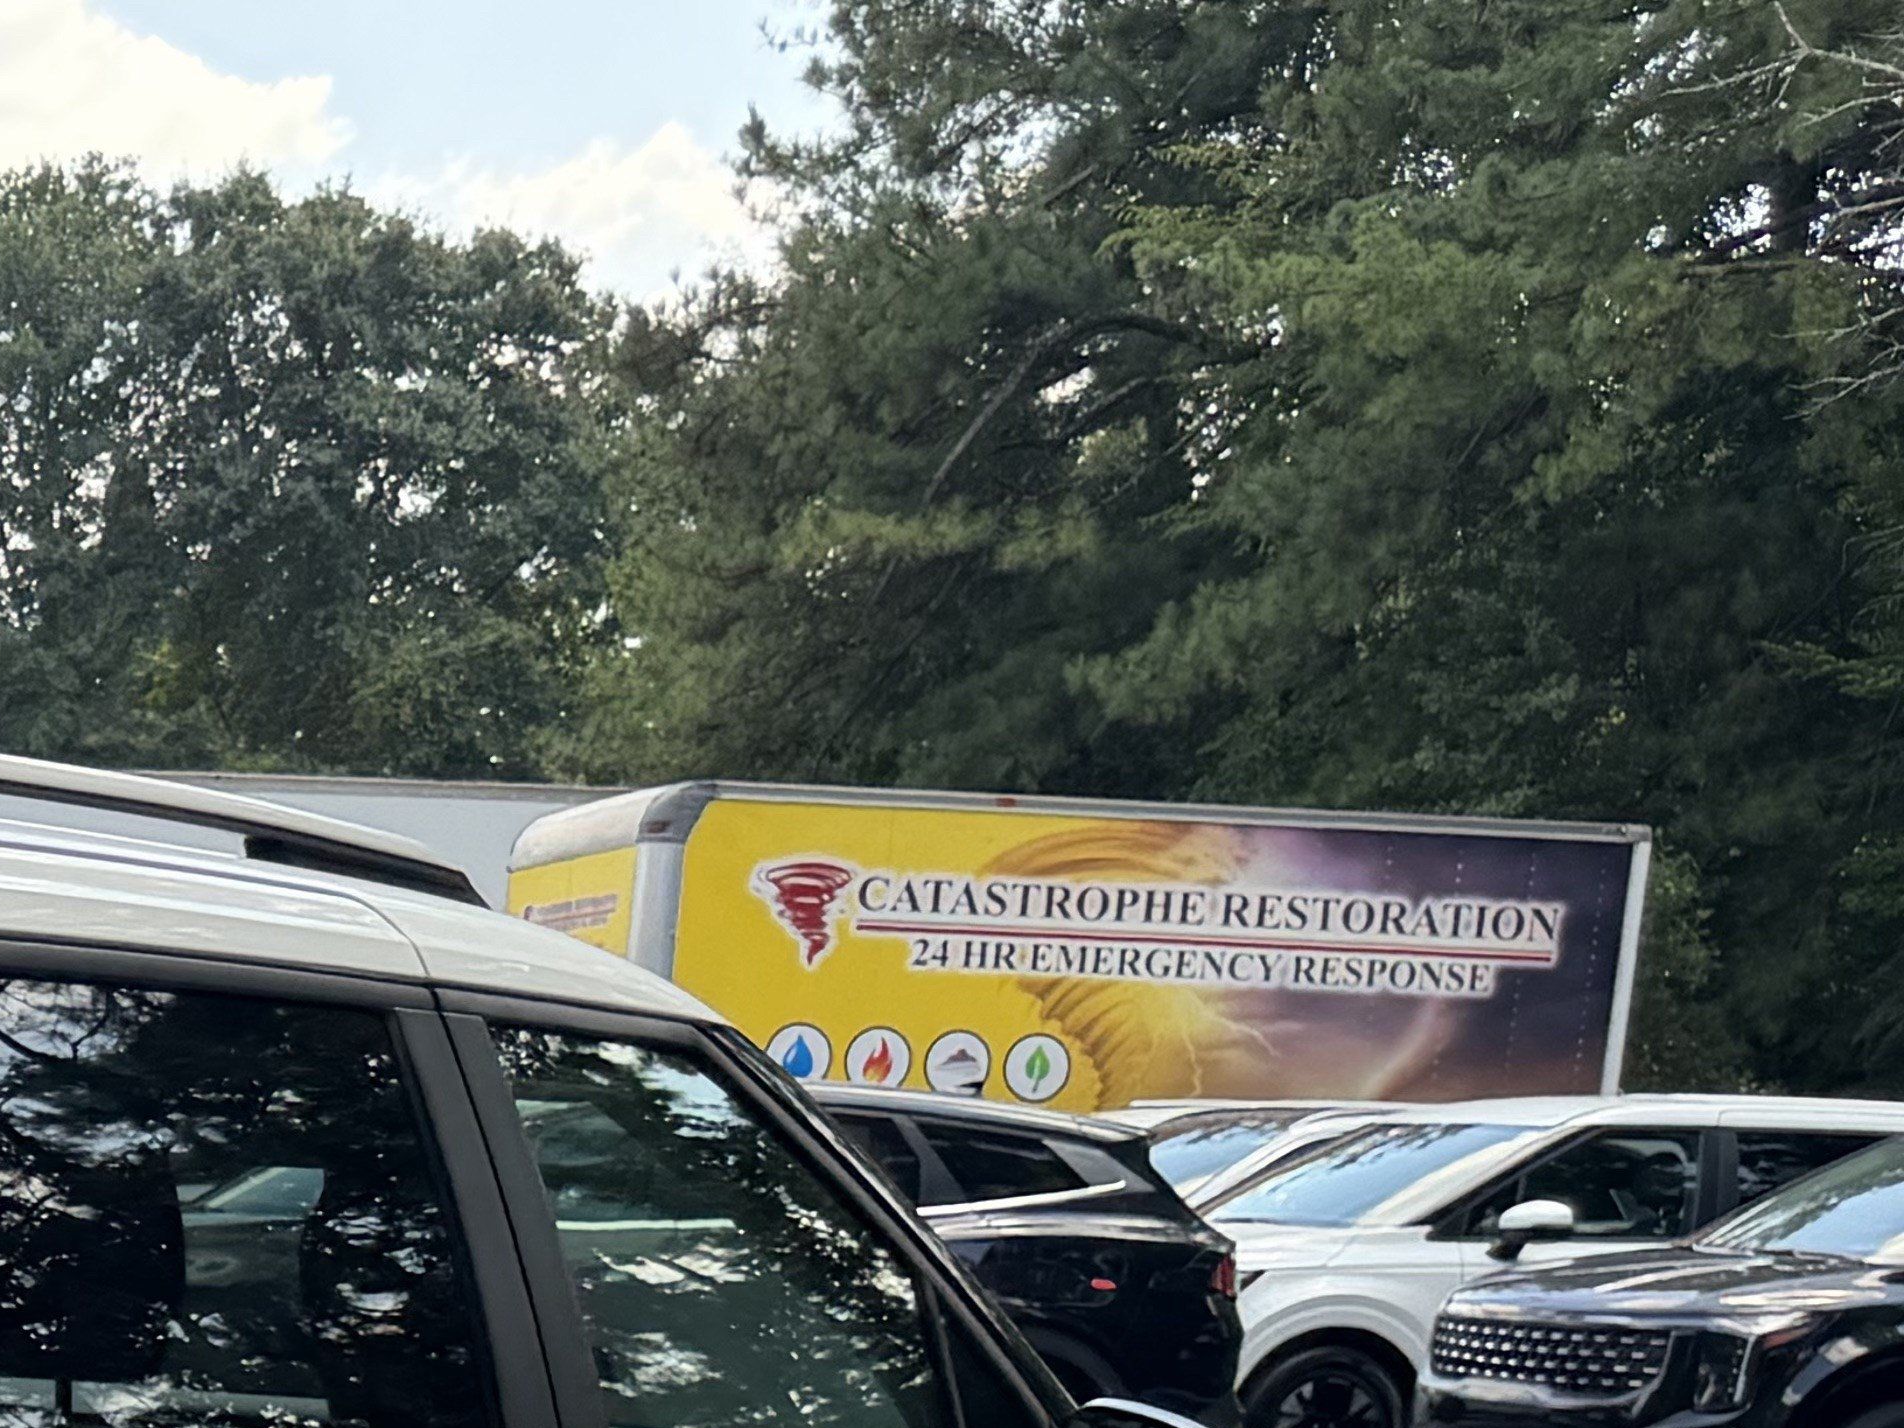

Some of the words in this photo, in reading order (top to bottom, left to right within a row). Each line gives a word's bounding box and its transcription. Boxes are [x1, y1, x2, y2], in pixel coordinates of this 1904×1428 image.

[857, 876, 1206, 926] CATASTROPHE
[1221, 892, 1560, 943] RESTORATION
[911, 938, 949, 967] 24
[963, 940, 1016, 971] HR
[1030, 943, 1282, 982] EMERGENCY
[1292, 955, 1492, 994] RESPONSE
